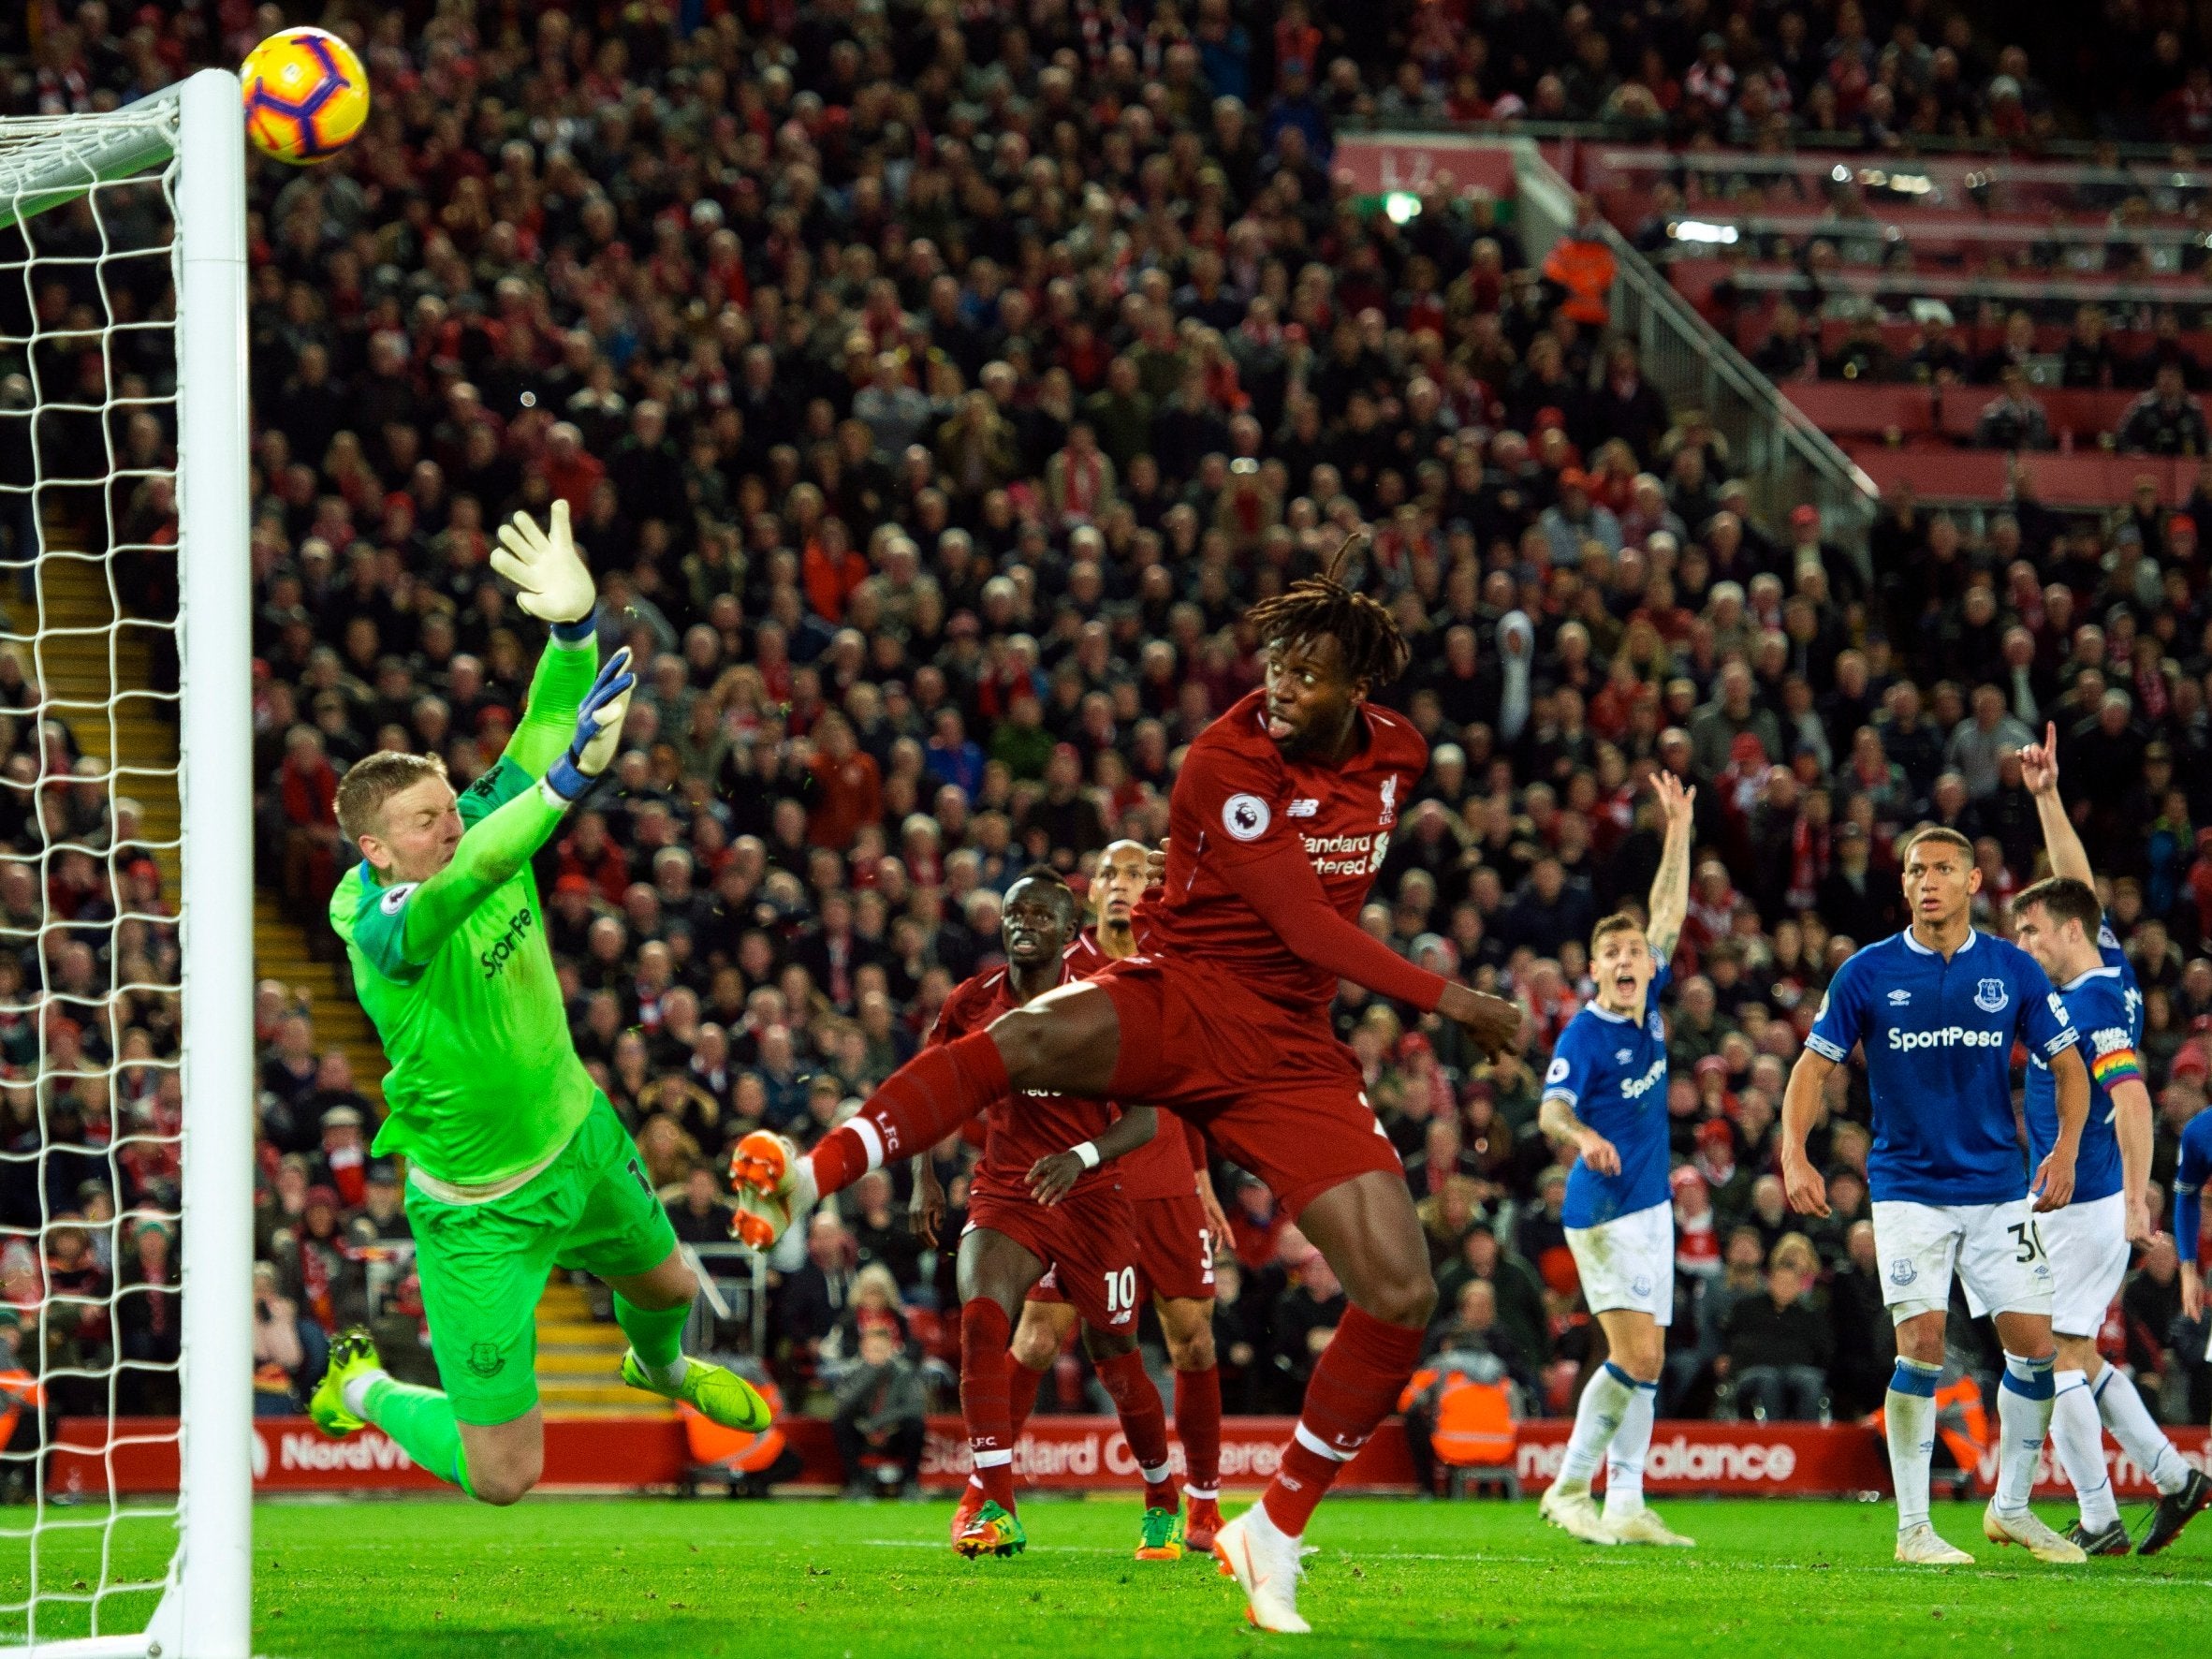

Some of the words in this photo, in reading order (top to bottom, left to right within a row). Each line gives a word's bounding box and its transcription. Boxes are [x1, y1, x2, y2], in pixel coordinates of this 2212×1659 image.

[1298, 832, 1371, 853] andard
[1888, 1026, 2003, 1052] SportPesa
[875, 1111, 900, 1154] LFC
[1104, 1266, 1135, 1312] 10
[281, 1431, 413, 1471] NordV
[917, 1431, 1099, 1475] Stadard
[967, 1435, 998, 1449] LFC
[1644, 1433, 1796, 1481] alance
